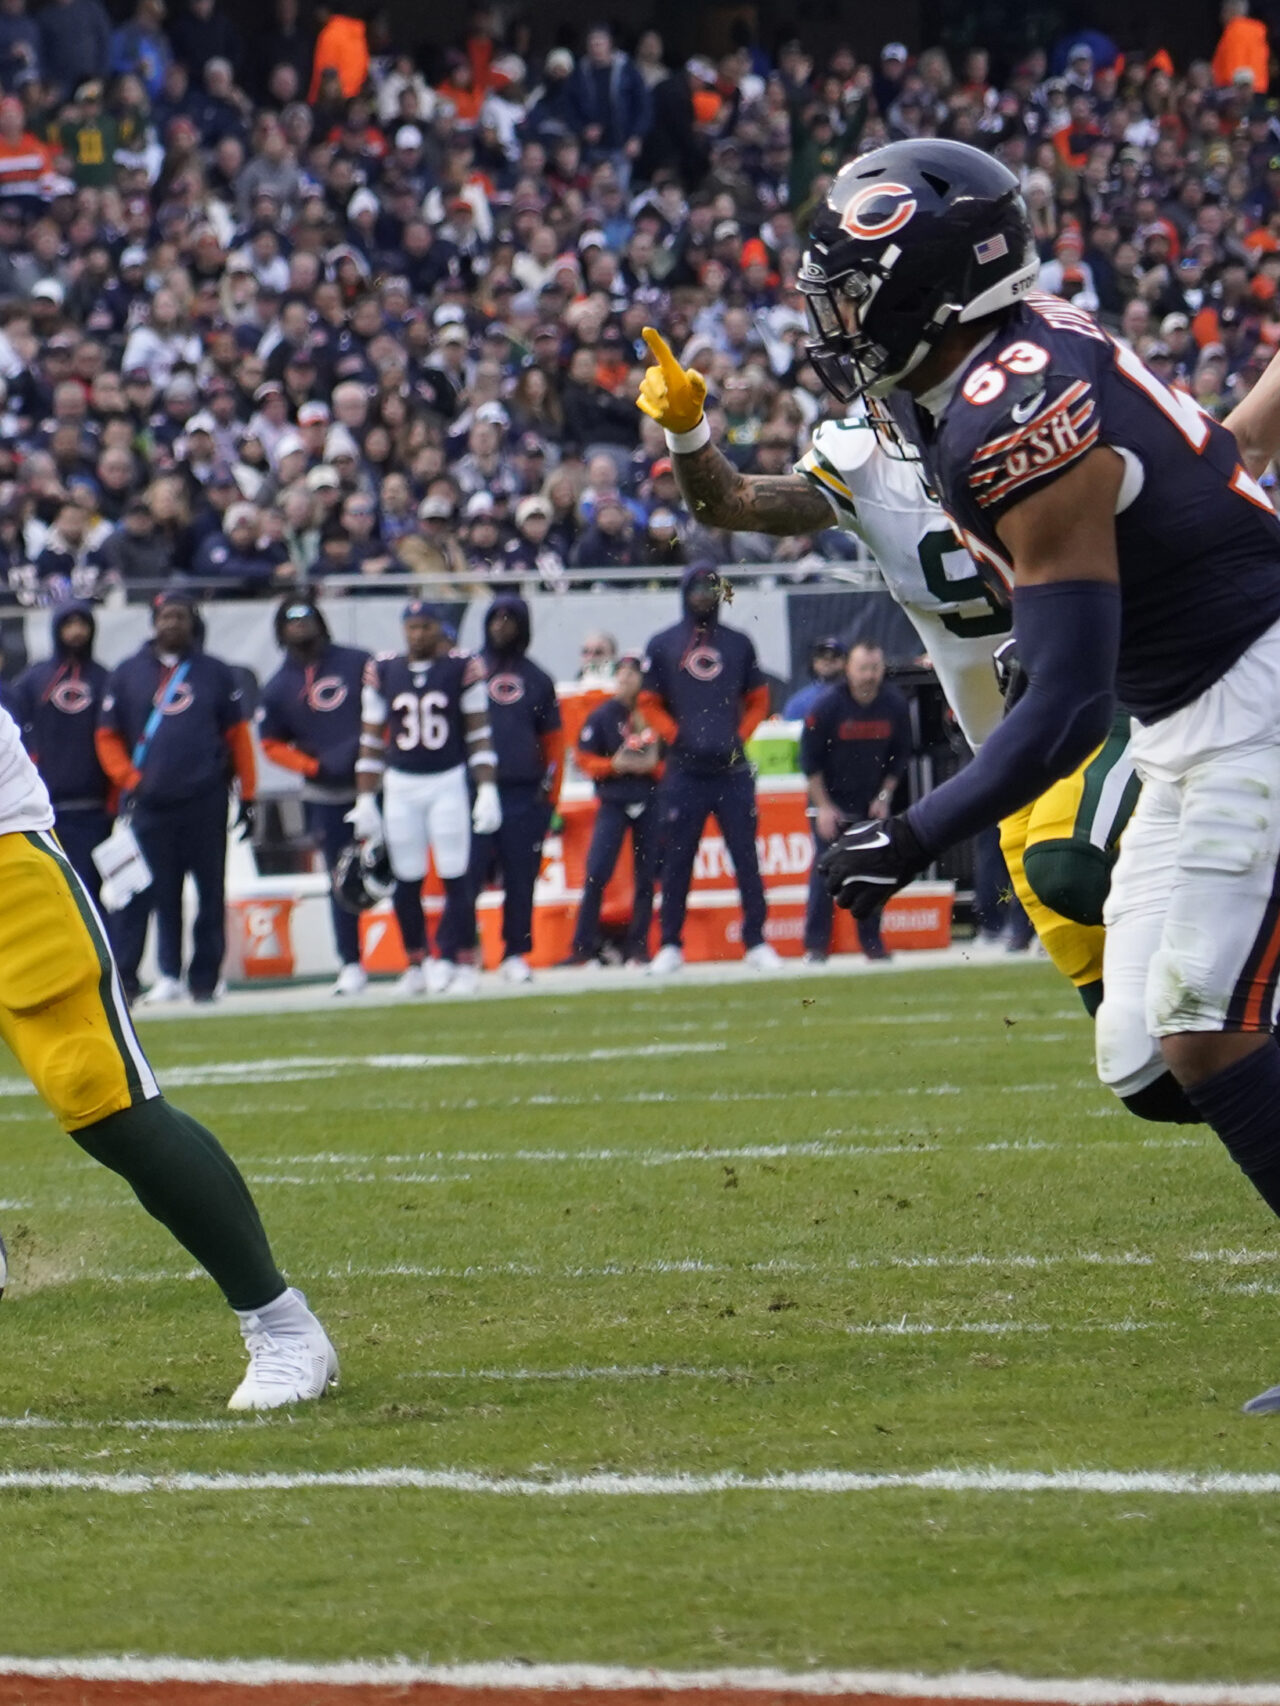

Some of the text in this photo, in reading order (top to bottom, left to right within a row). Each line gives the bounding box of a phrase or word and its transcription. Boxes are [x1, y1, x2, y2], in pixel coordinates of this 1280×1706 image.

[962, 340, 1050, 406] 53
[1005, 409, 1080, 478] GSH
[391, 690, 450, 751] 36
